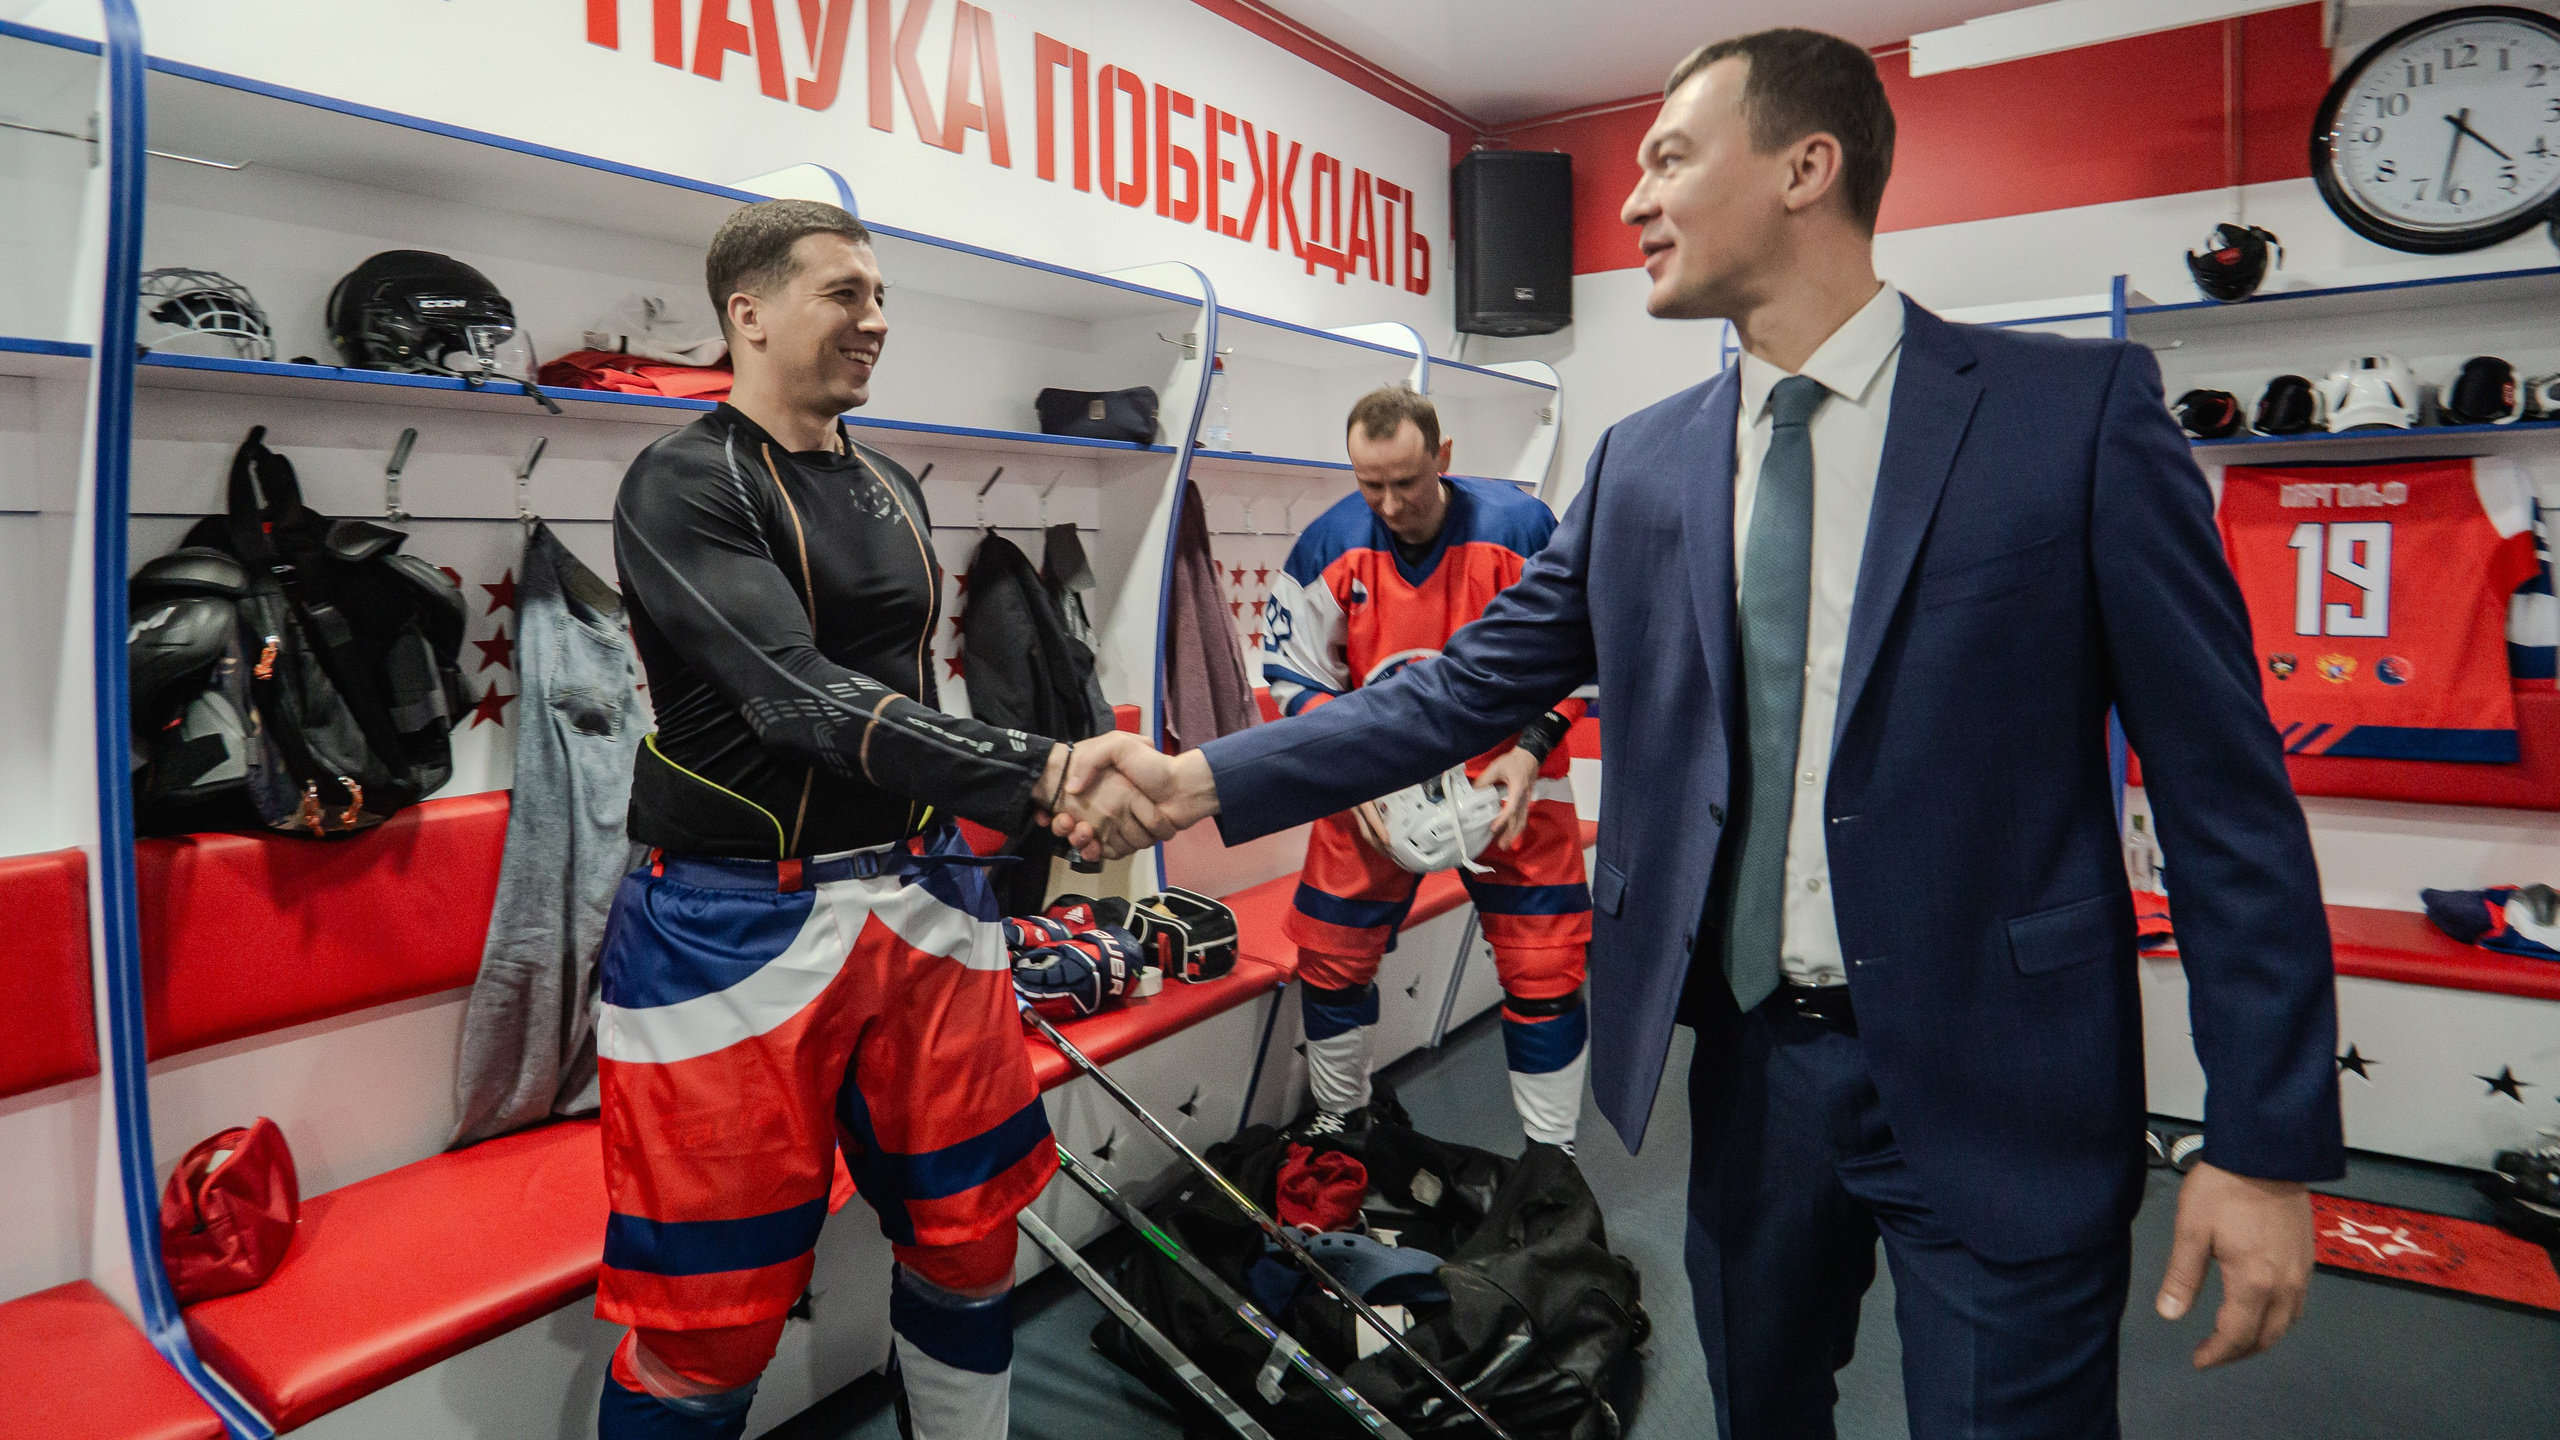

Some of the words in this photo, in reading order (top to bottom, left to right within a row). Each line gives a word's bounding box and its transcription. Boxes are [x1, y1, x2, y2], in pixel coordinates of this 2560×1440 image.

[2443, 44, 2478, 69] 12
[2498, 48, 2510, 70] 1
[2406, 62, 2434, 87] 11
[2525, 63, 2547, 88] 2
[2376, 93, 2410, 118] 10
[2361, 126, 2384, 150] 9
[2526, 136, 2549, 159] 4
[1035, 32, 1431, 296] ПОБЕЖДАТЬ
[2376, 159, 2397, 183] 8
[2410, 178, 2431, 201] 7
[2498, 165, 2519, 194] 5
[2287, 521, 2392, 637] 19
